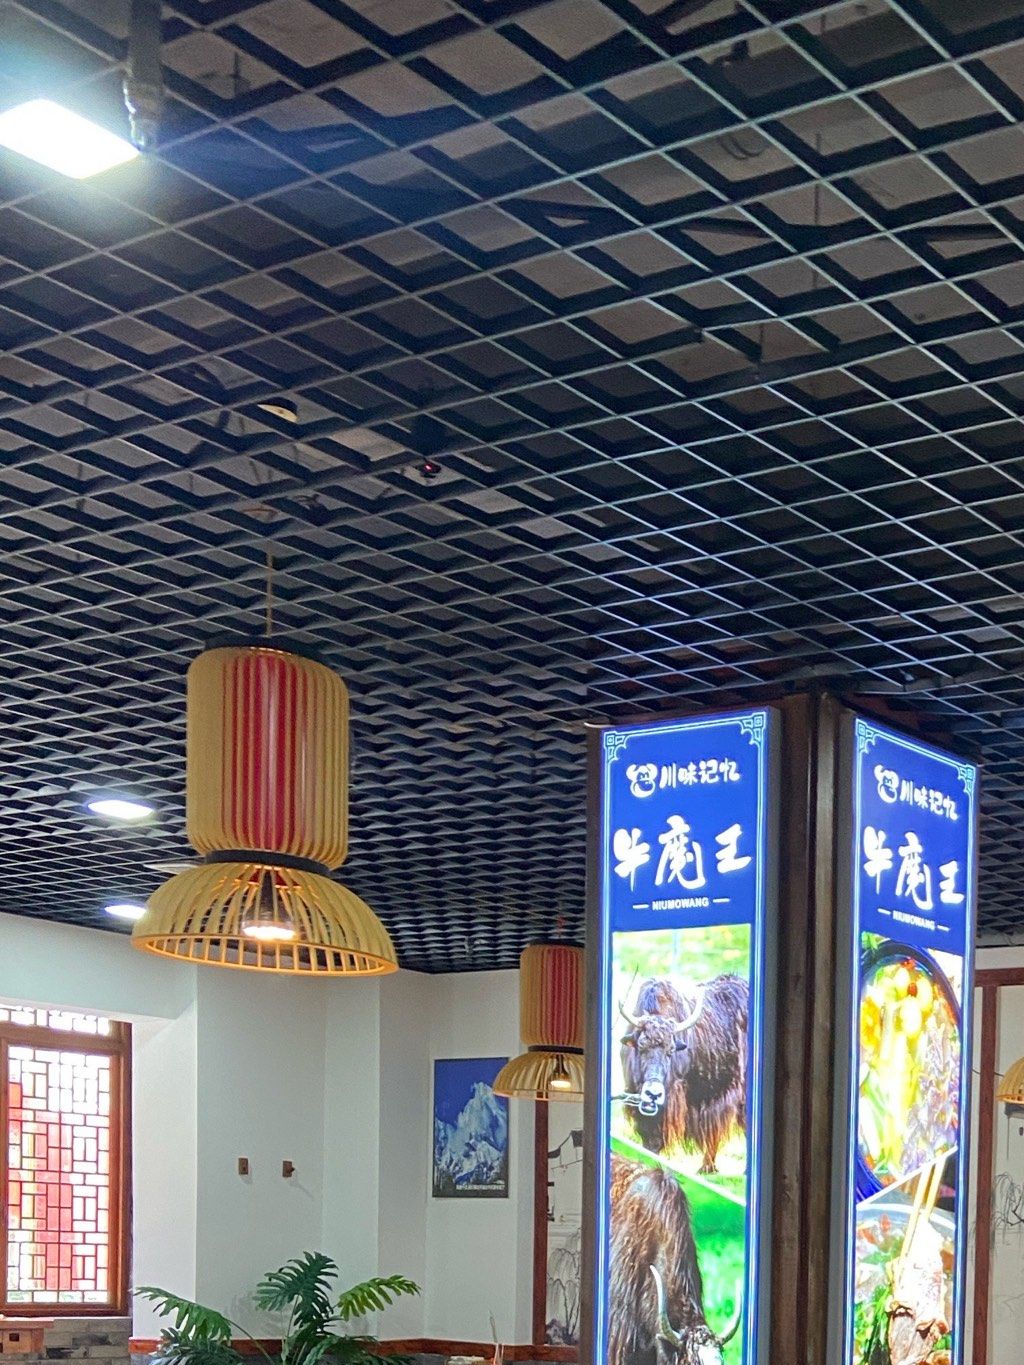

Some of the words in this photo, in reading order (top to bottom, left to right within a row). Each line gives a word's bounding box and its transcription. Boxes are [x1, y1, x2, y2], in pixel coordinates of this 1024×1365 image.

[659, 757, 741, 789] 川味记忆
[899, 780, 958, 820] 川味记忆
[613, 814, 753, 892] 牛魔王
[862, 826, 965, 910] 牛魔王
[652, 896, 710, 911] NIUMOWANG
